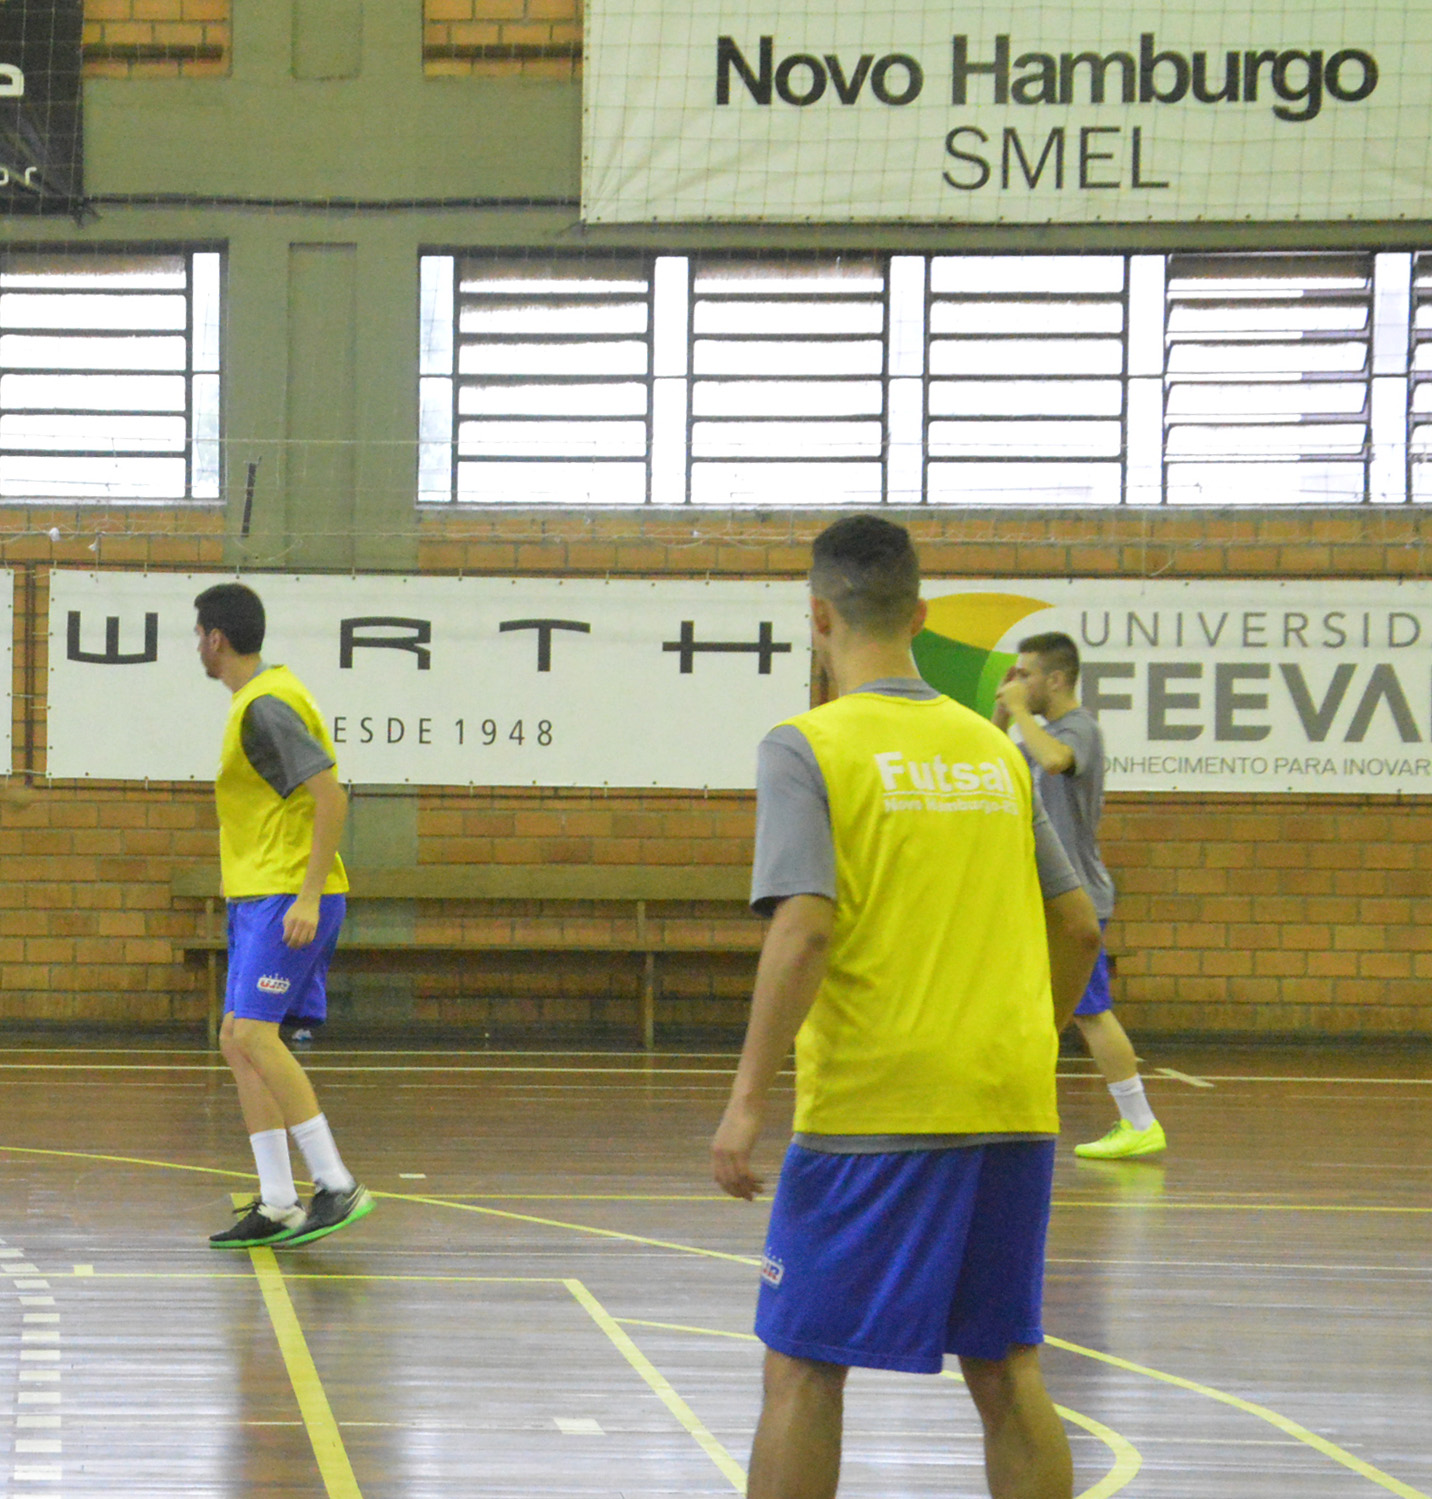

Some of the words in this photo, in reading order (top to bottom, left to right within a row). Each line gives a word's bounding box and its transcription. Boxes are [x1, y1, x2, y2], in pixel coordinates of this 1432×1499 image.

[715, 35, 924, 107] Novo
[951, 32, 1380, 123] Hamburgo
[942, 126, 1170, 191] SMEL
[67, 610, 792, 675] WRTH
[1081, 611, 1422, 648] UNIVERSID
[1080, 661, 1432, 742] FEEVA
[332, 716, 432, 745] ESDE
[455, 718, 553, 746] 1948
[874, 751, 1014, 794] Futsal
[1103, 756, 1269, 774] NHECIMENTO
[1274, 756, 1337, 775] PARA
[1343, 757, 1432, 776] INOVAR
